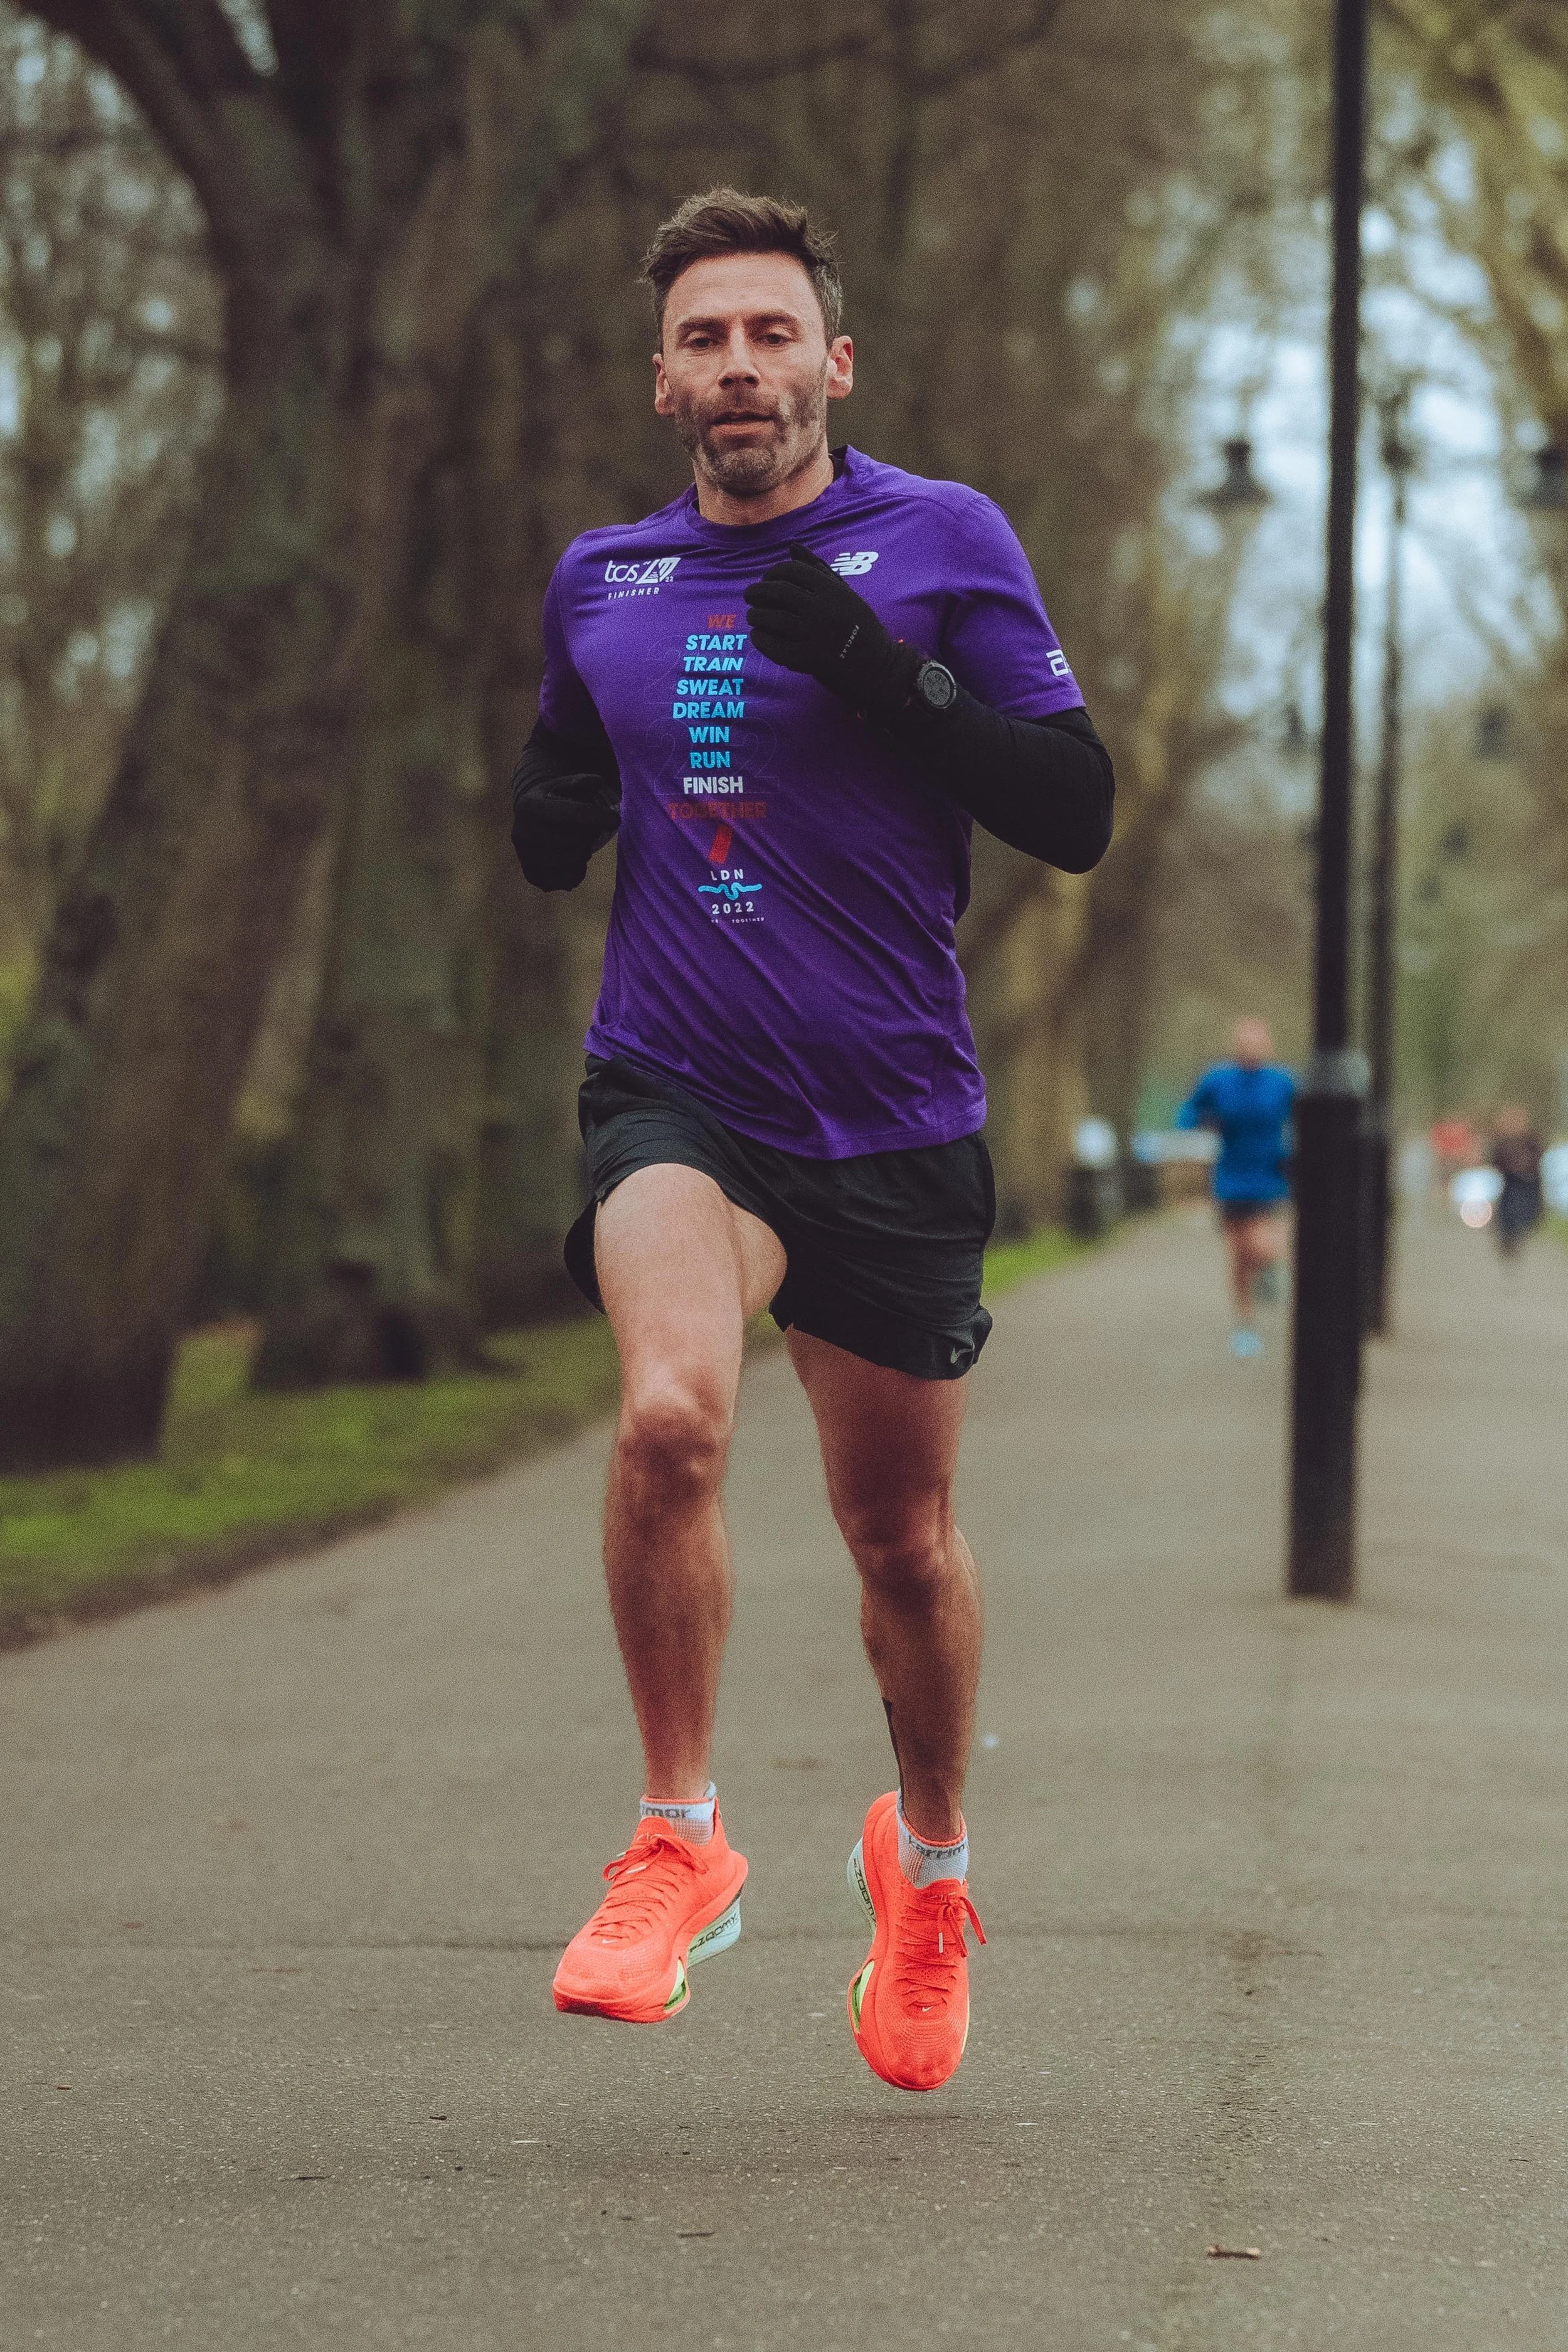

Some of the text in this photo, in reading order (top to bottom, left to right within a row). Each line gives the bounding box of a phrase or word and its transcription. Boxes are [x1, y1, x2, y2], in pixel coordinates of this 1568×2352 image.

[608, 586, 660, 600] FINISHER
[707, 613, 736, 630] WE
[685, 633, 748, 652] START
[683, 655, 744, 672] TRAIN
[675, 678, 743, 697] SWEAT
[672, 700, 746, 720] DREAM
[688, 726, 729, 743] WIN
[690, 751, 730, 768] RUN
[684, 777, 743, 793] FINISH
[668, 802, 766, 820] TOGETHER
[711, 869, 744, 881] LDN
[712, 901, 754, 914] 2022
